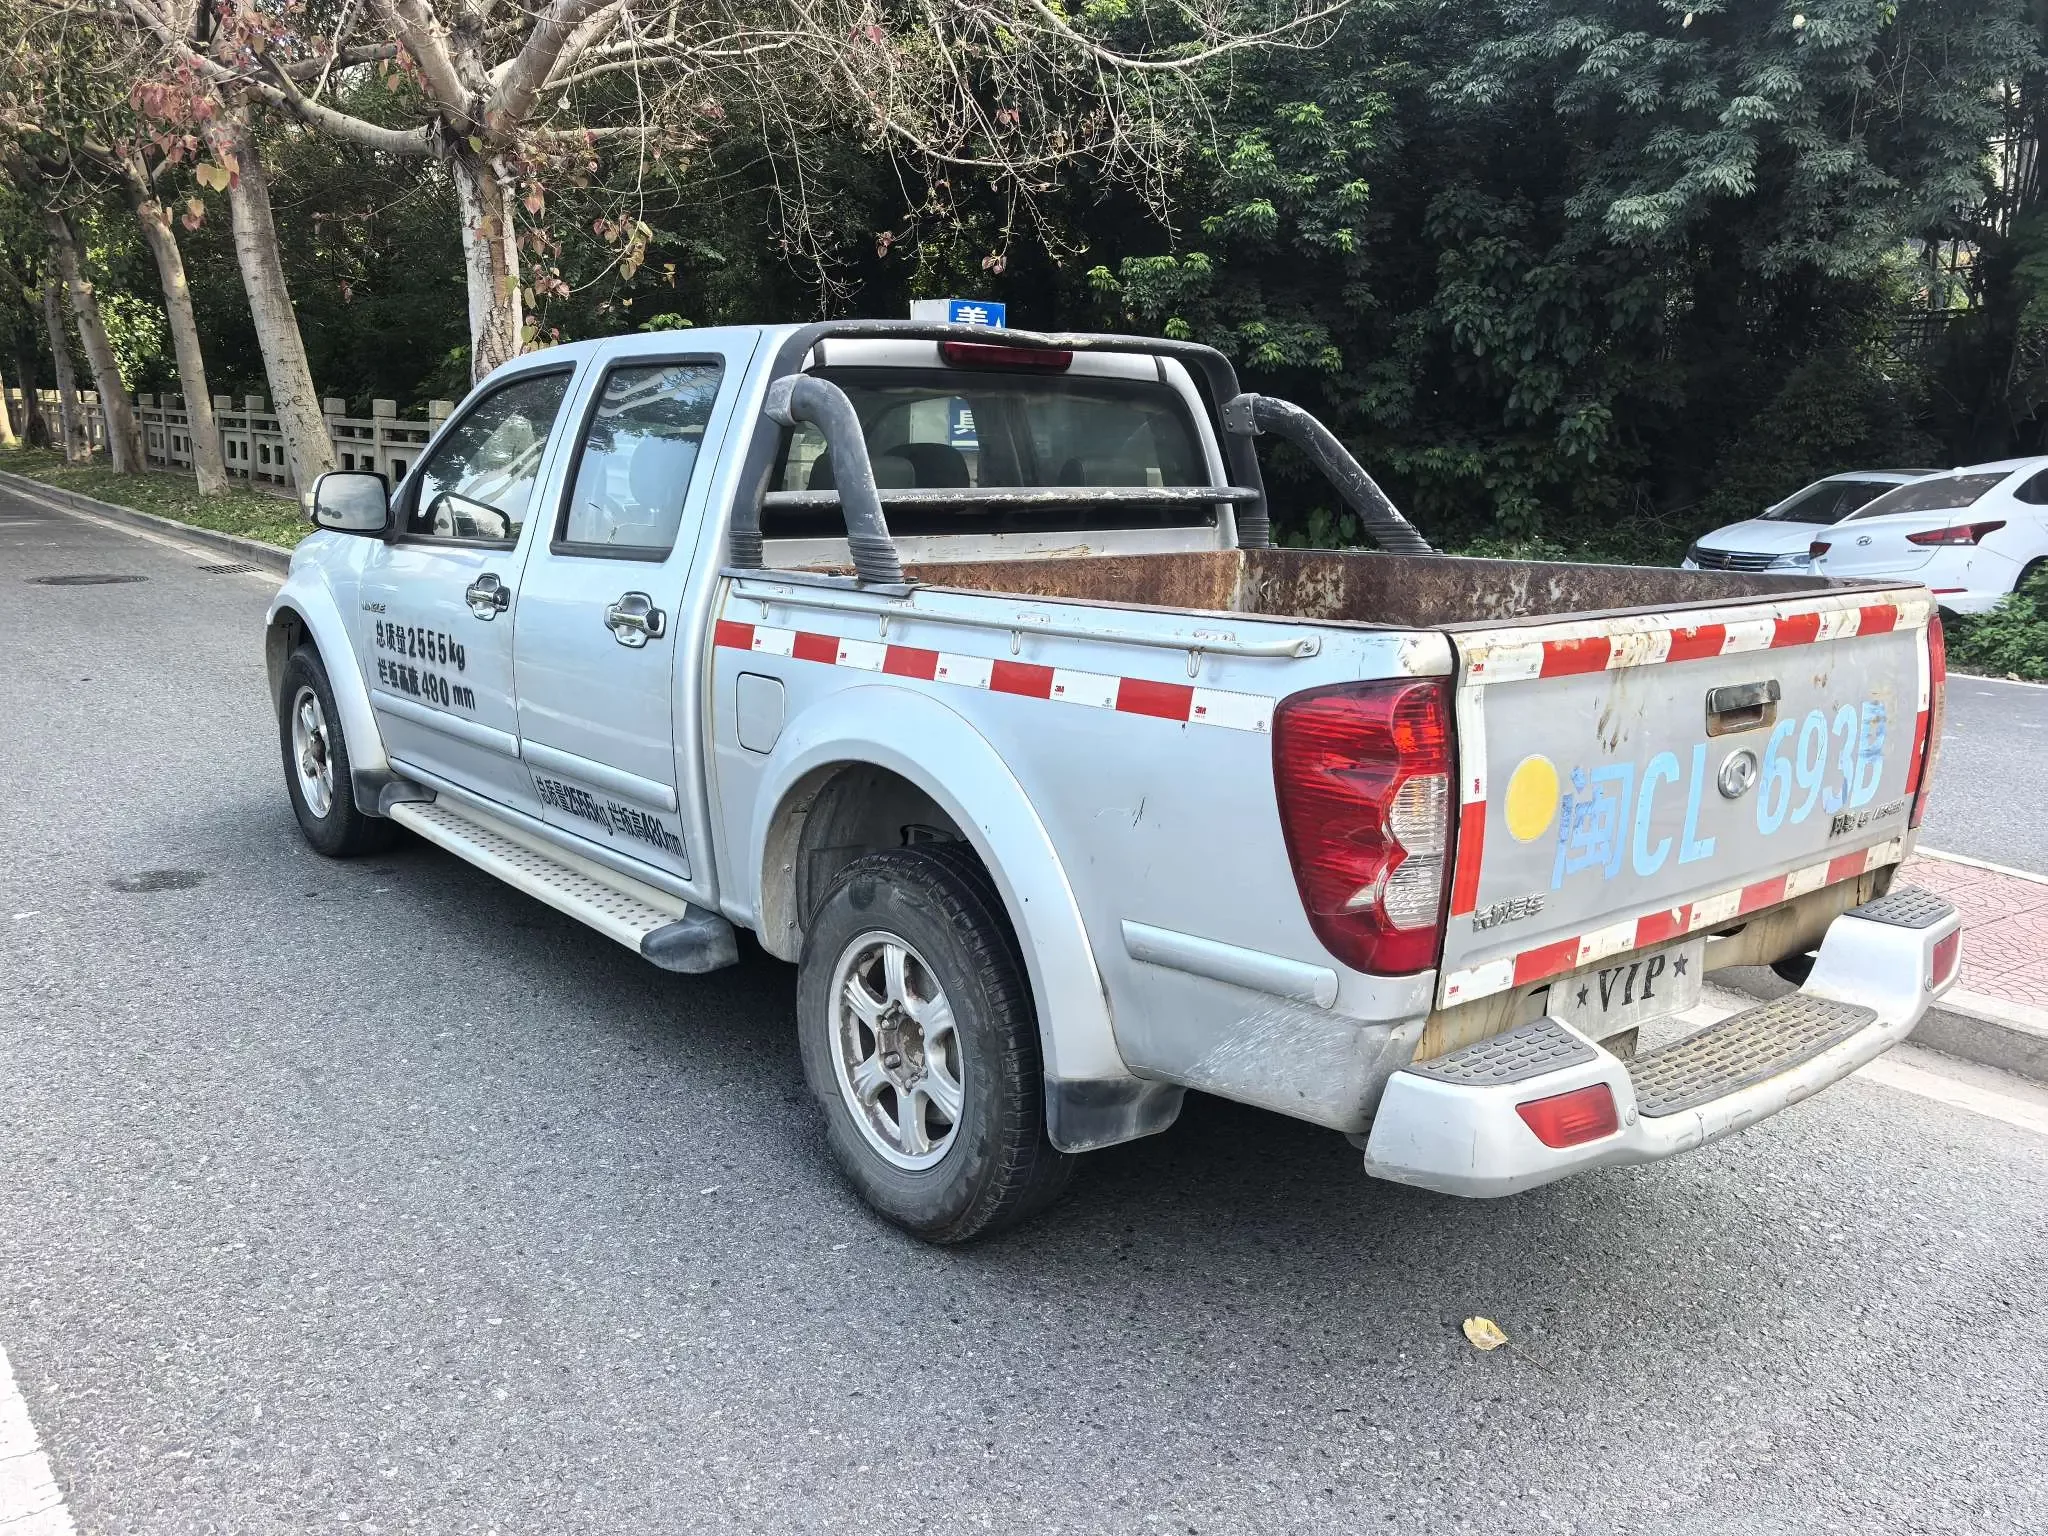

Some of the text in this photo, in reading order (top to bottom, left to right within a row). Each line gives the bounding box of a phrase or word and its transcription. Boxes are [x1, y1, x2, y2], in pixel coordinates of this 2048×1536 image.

[1472, 663, 1485, 673] 3M
[1054, 685, 1065, 693] 3M
[1194, 705, 1207, 715] 3M
[1598, 953, 1666, 1013] VIP
[1448, 985, 1460, 995] 3M
